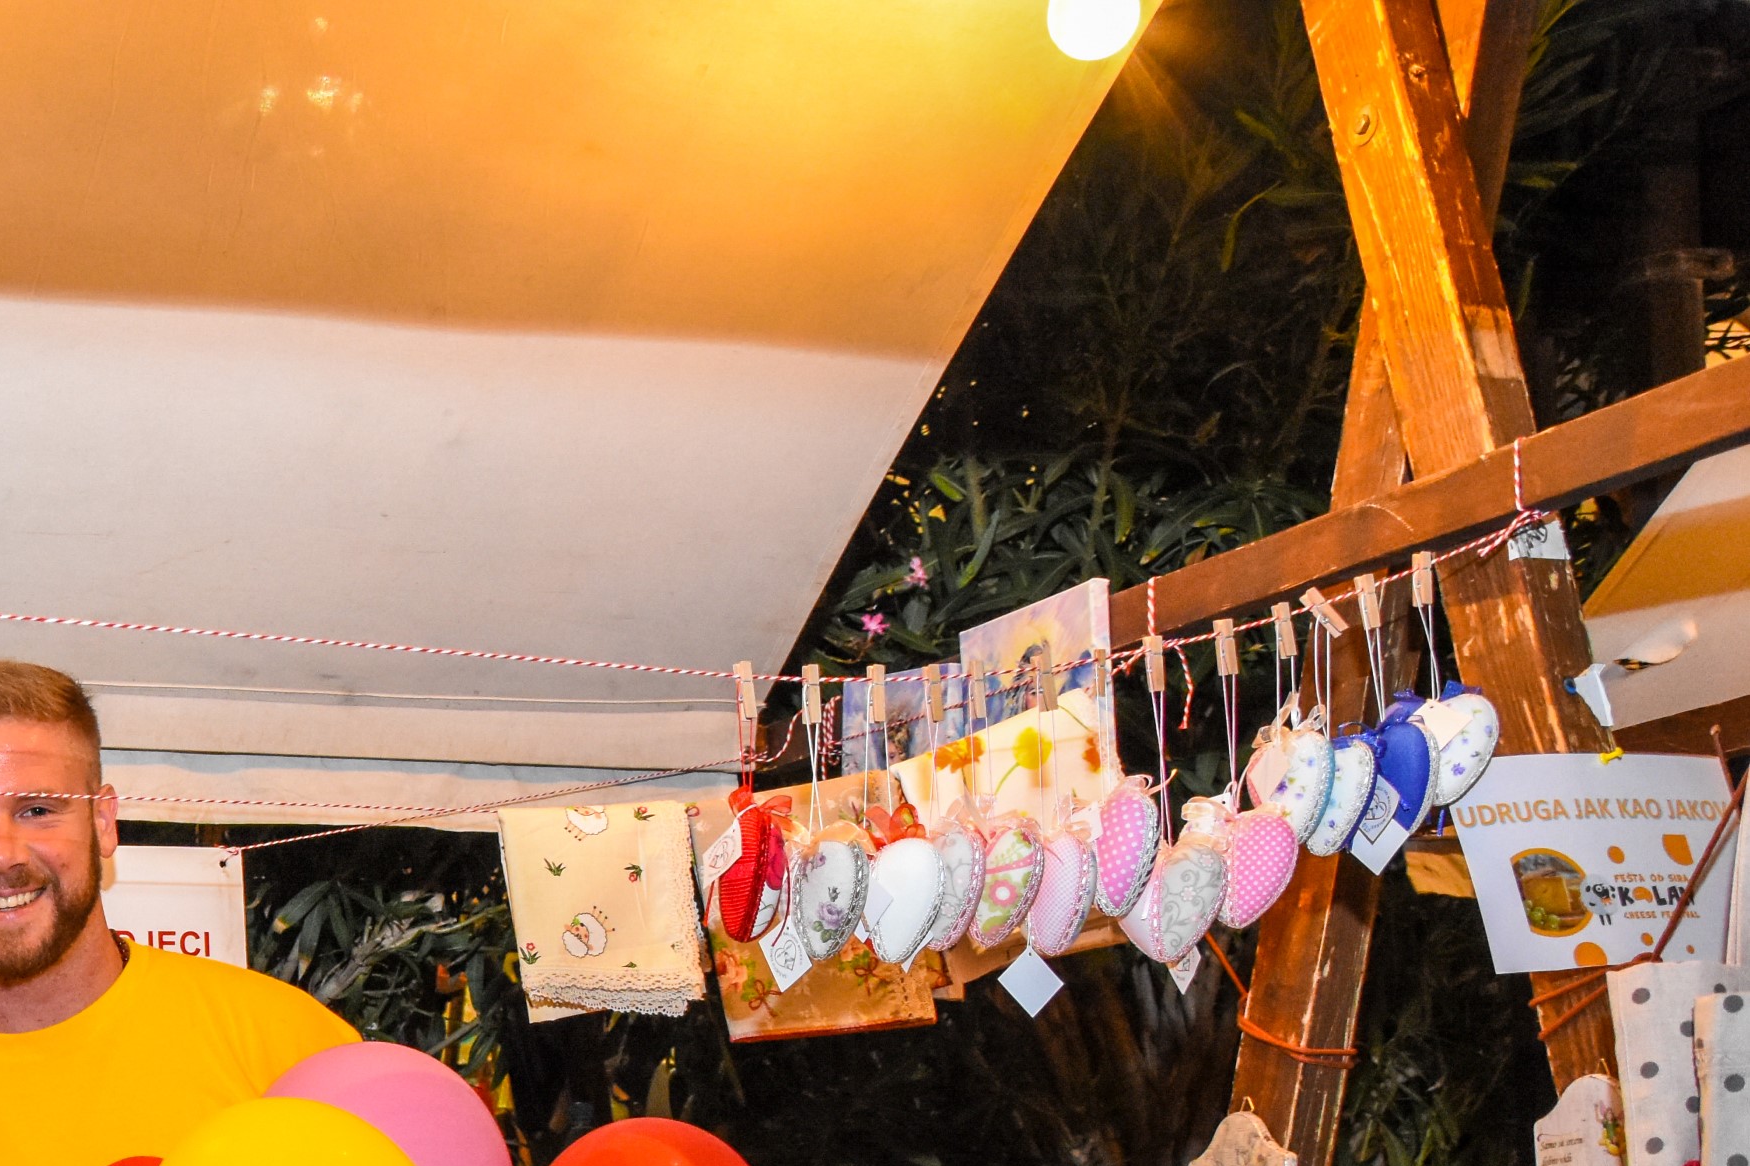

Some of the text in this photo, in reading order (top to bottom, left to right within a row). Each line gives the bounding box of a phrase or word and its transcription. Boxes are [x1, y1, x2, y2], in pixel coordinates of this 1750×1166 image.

[1456, 799, 1569, 828] UDRUGA
[1575, 798, 1610, 820] JAK
[1617, 798, 1661, 819] KAO
